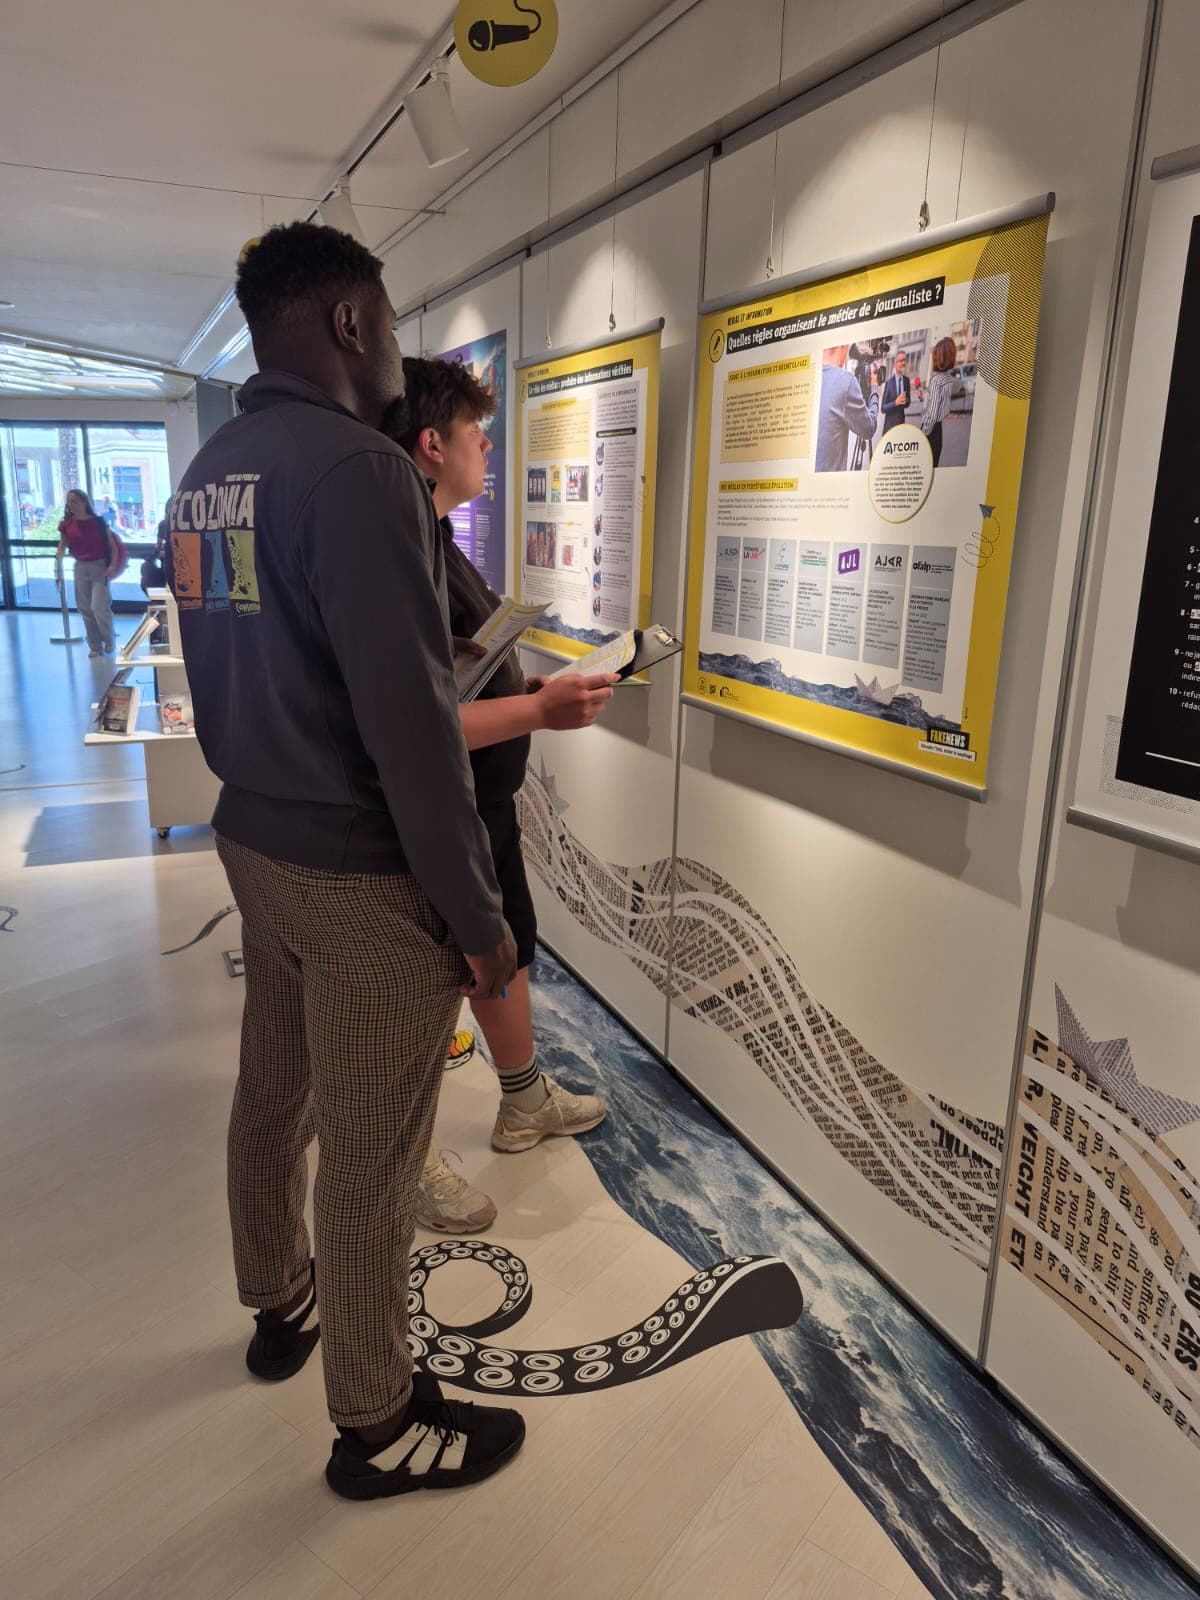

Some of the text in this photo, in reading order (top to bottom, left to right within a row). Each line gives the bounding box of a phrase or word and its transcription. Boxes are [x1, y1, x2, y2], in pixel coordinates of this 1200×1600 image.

[728, 284, 942, 350] Quelles règles organisent le métier de journaliste ?
[883, 441, 919, 455] Arcom
[1194, 516, 1199, 524] 4
[840, 553, 857, 570] AJL
[1187, 563, 1192, 571] 6
[1184, 580, 1190, 588] 7
[931, 729, 966, 748] FAKENEWS
[851, 1057, 867, 1068] You
[939, 1100, 1005, 1152] appear on
[1037, 1146, 1055, 1233] understand
[1054, 1189, 1067, 1215] the
[1067, 1190, 1080, 1230] your
[1096, 1207, 1110, 1247] send
[1034, 1241, 1043, 1261] on
[1112, 1241, 1123, 1260] to
[1127, 1242, 1140, 1273] nd
[1091, 1253, 1104, 1272] us,
